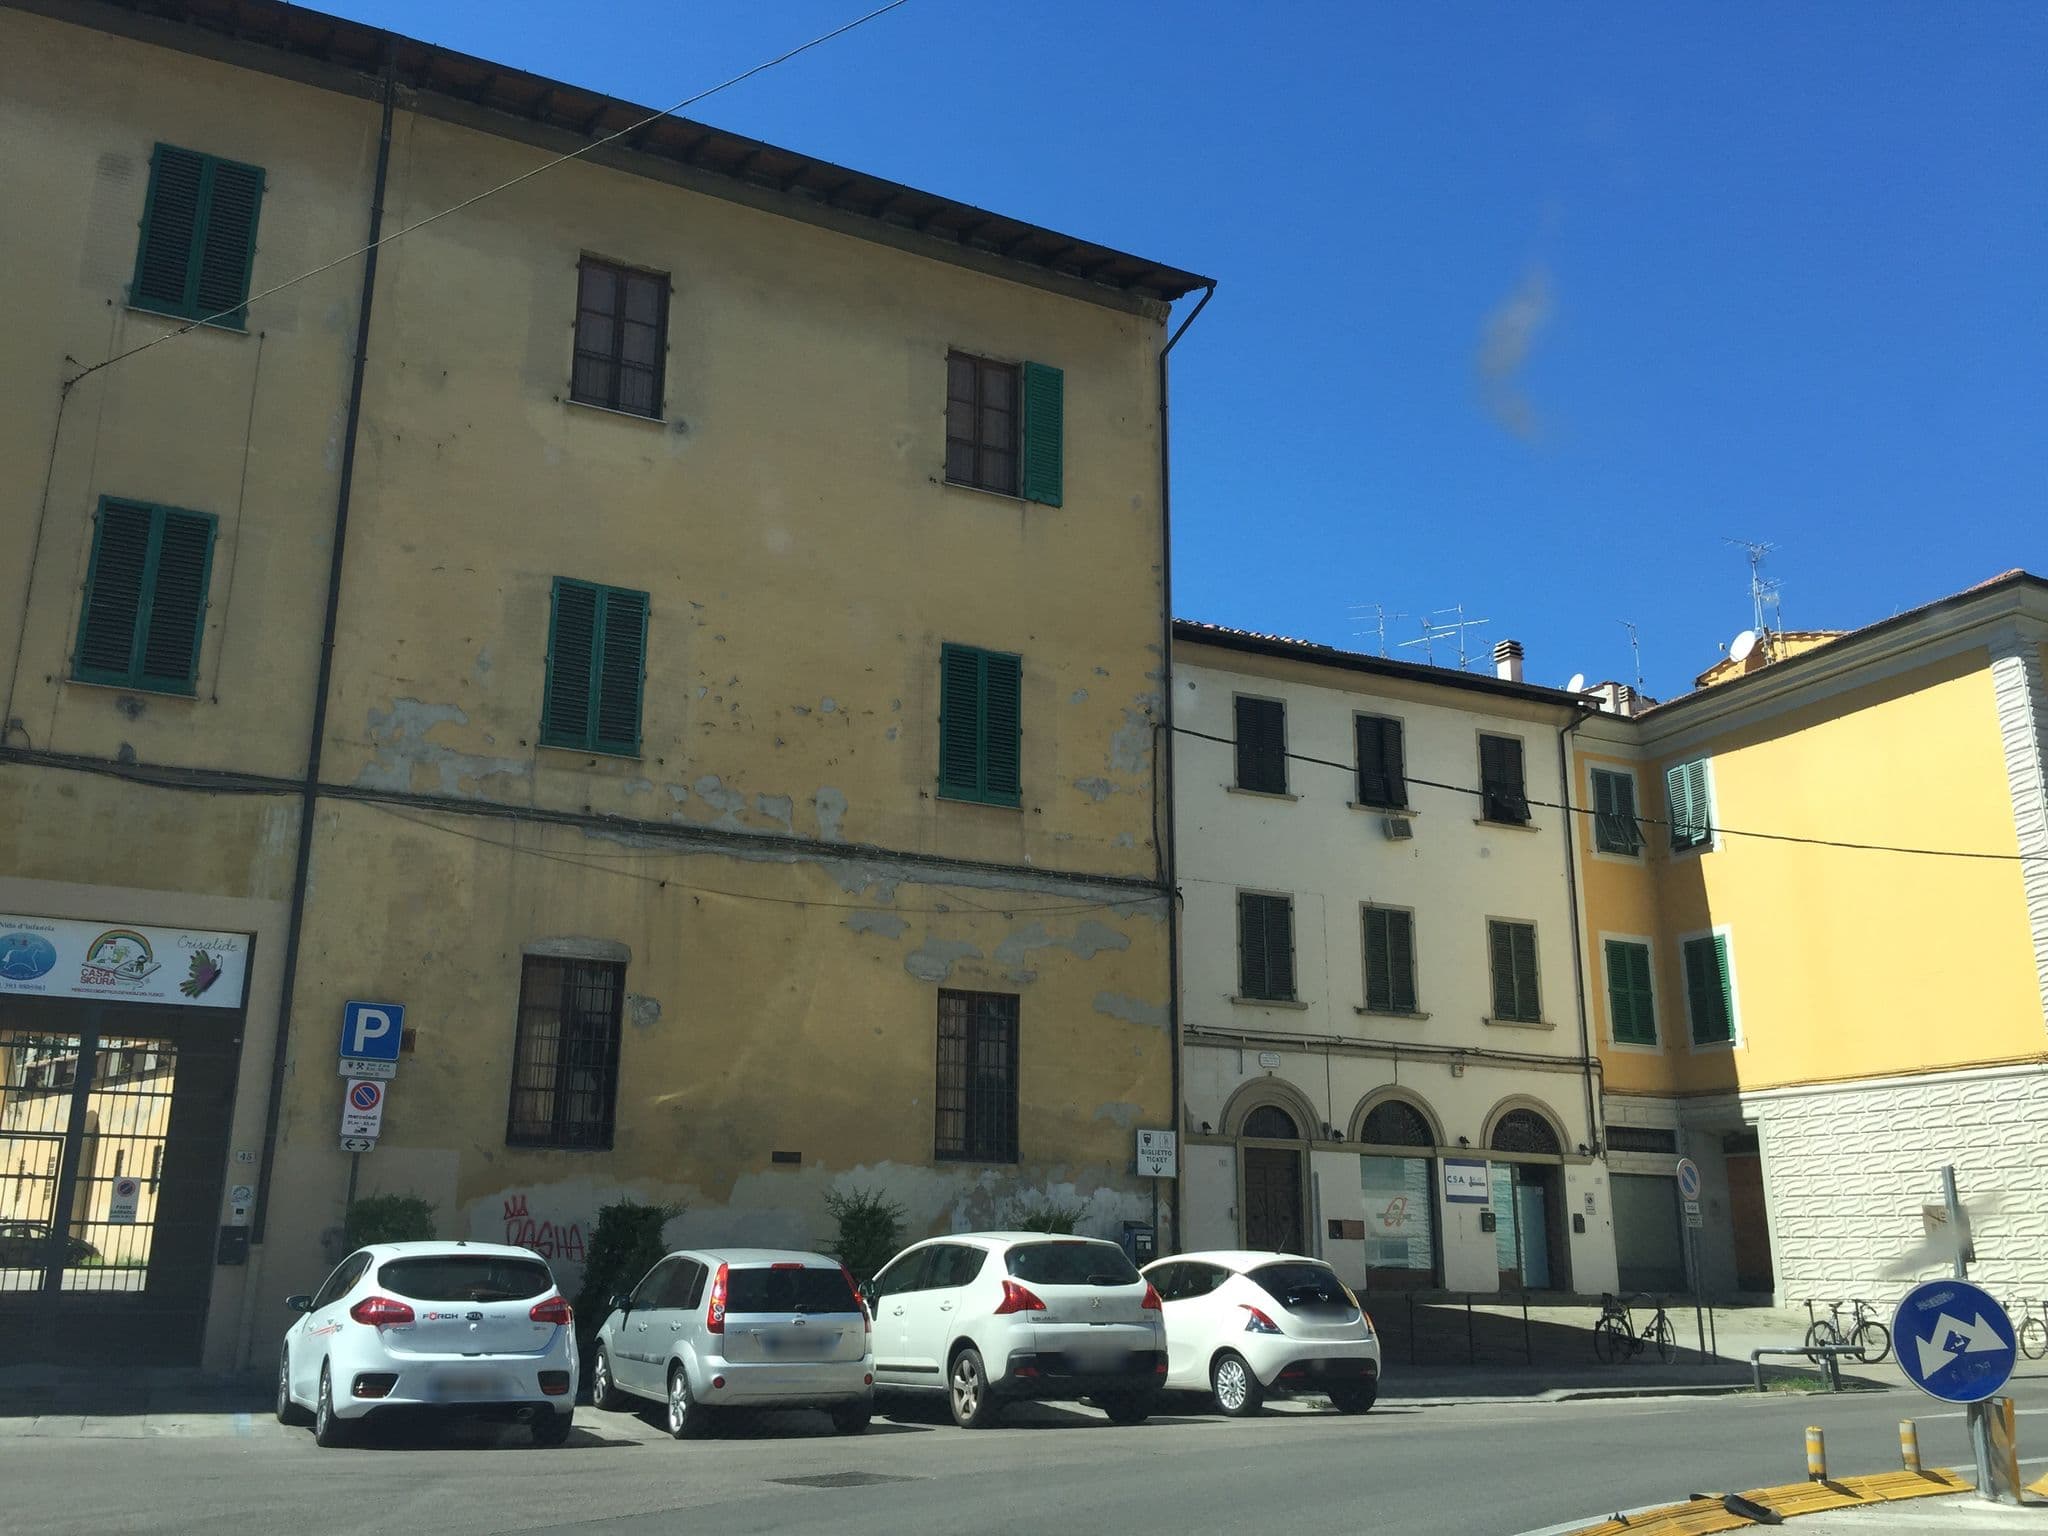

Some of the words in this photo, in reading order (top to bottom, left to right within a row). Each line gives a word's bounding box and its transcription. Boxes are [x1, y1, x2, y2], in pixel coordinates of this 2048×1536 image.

[81, 968, 111, 978] CASA
[80, 975, 116, 986] SICURA
[353, 1008, 391, 1052] P
[1141, 1148, 1173, 1156] BIGLIETTO
